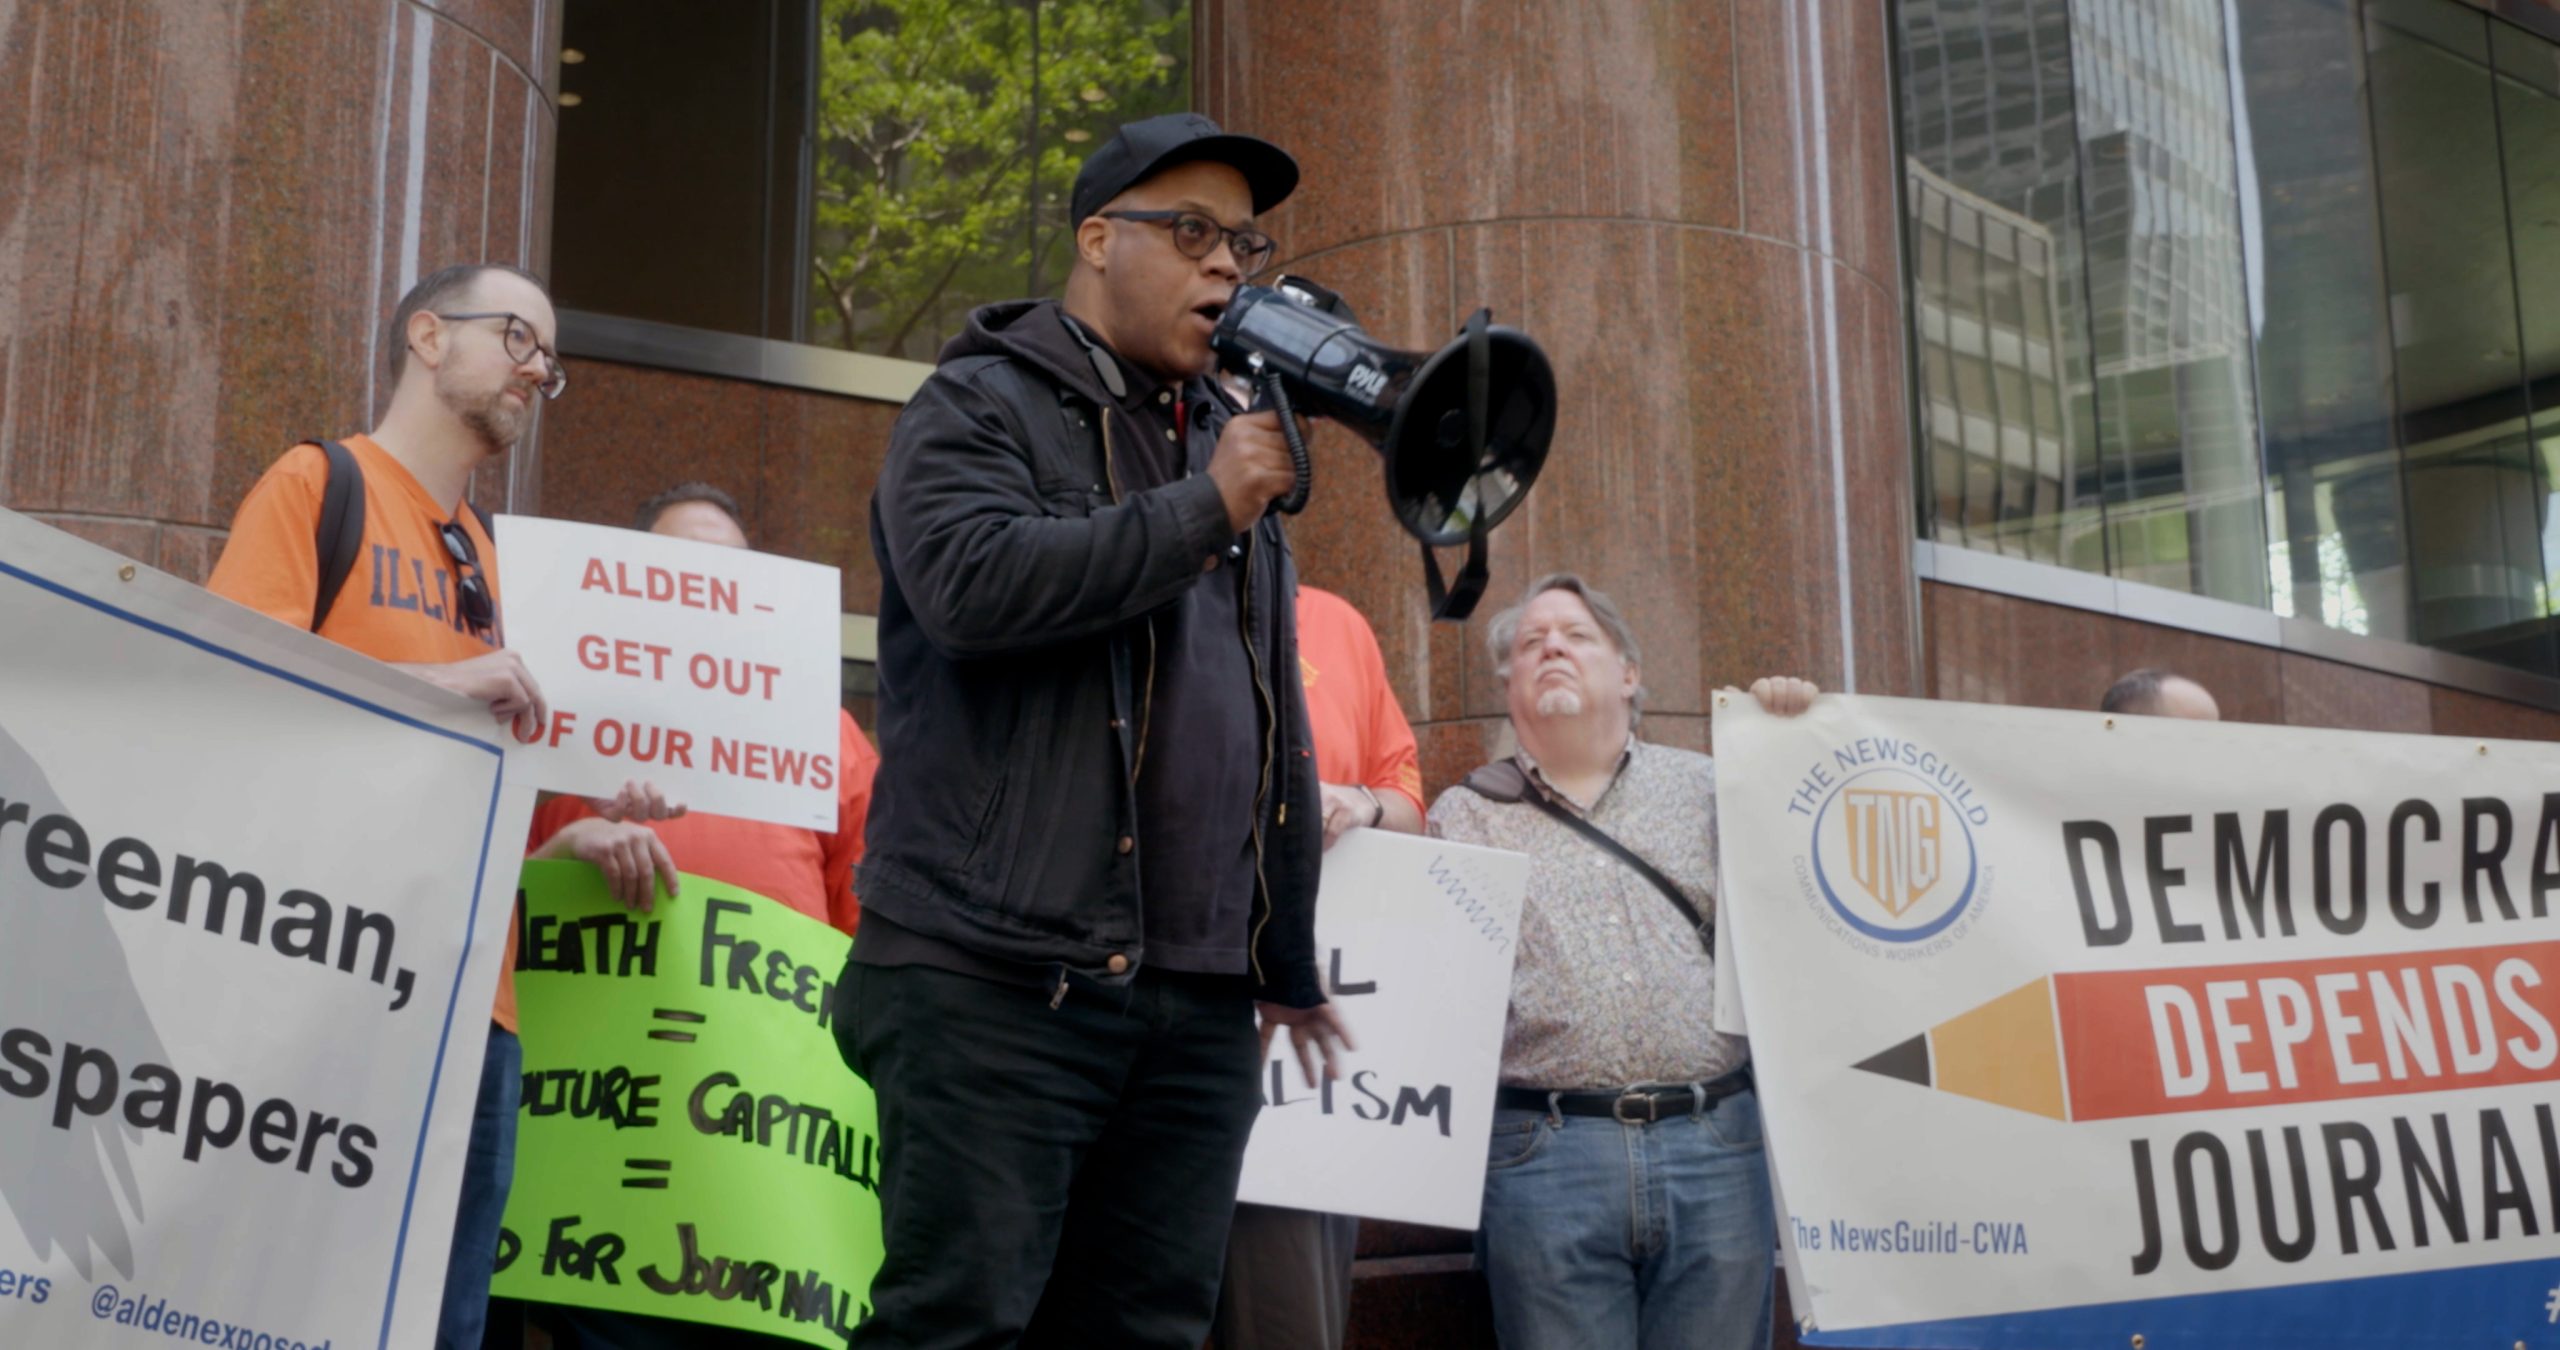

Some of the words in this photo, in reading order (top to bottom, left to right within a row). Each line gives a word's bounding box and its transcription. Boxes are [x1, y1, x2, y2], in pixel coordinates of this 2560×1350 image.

[580, 557, 740, 616] ALDEN
[577, 634, 672, 681] GET
[689, 653, 782, 701] OUT
[592, 718, 694, 768] OUR
[710, 736, 835, 791] NEWS
[1788, 762, 1835, 816] THE
[1833, 736, 1989, 827] NEWSGUILD
[1849, 793, 1937, 918] TNG
[2062, 792, 2560, 948] DEMOCRA
[2144, 957, 2560, 1098] DEPENDS
[0, 1027, 378, 1189] spapers
[688, 1072, 881, 1198] CAPITALI
[540, 1216, 626, 1285] FOR
[1829, 1218, 2030, 1255] NewsGuild-CWA
